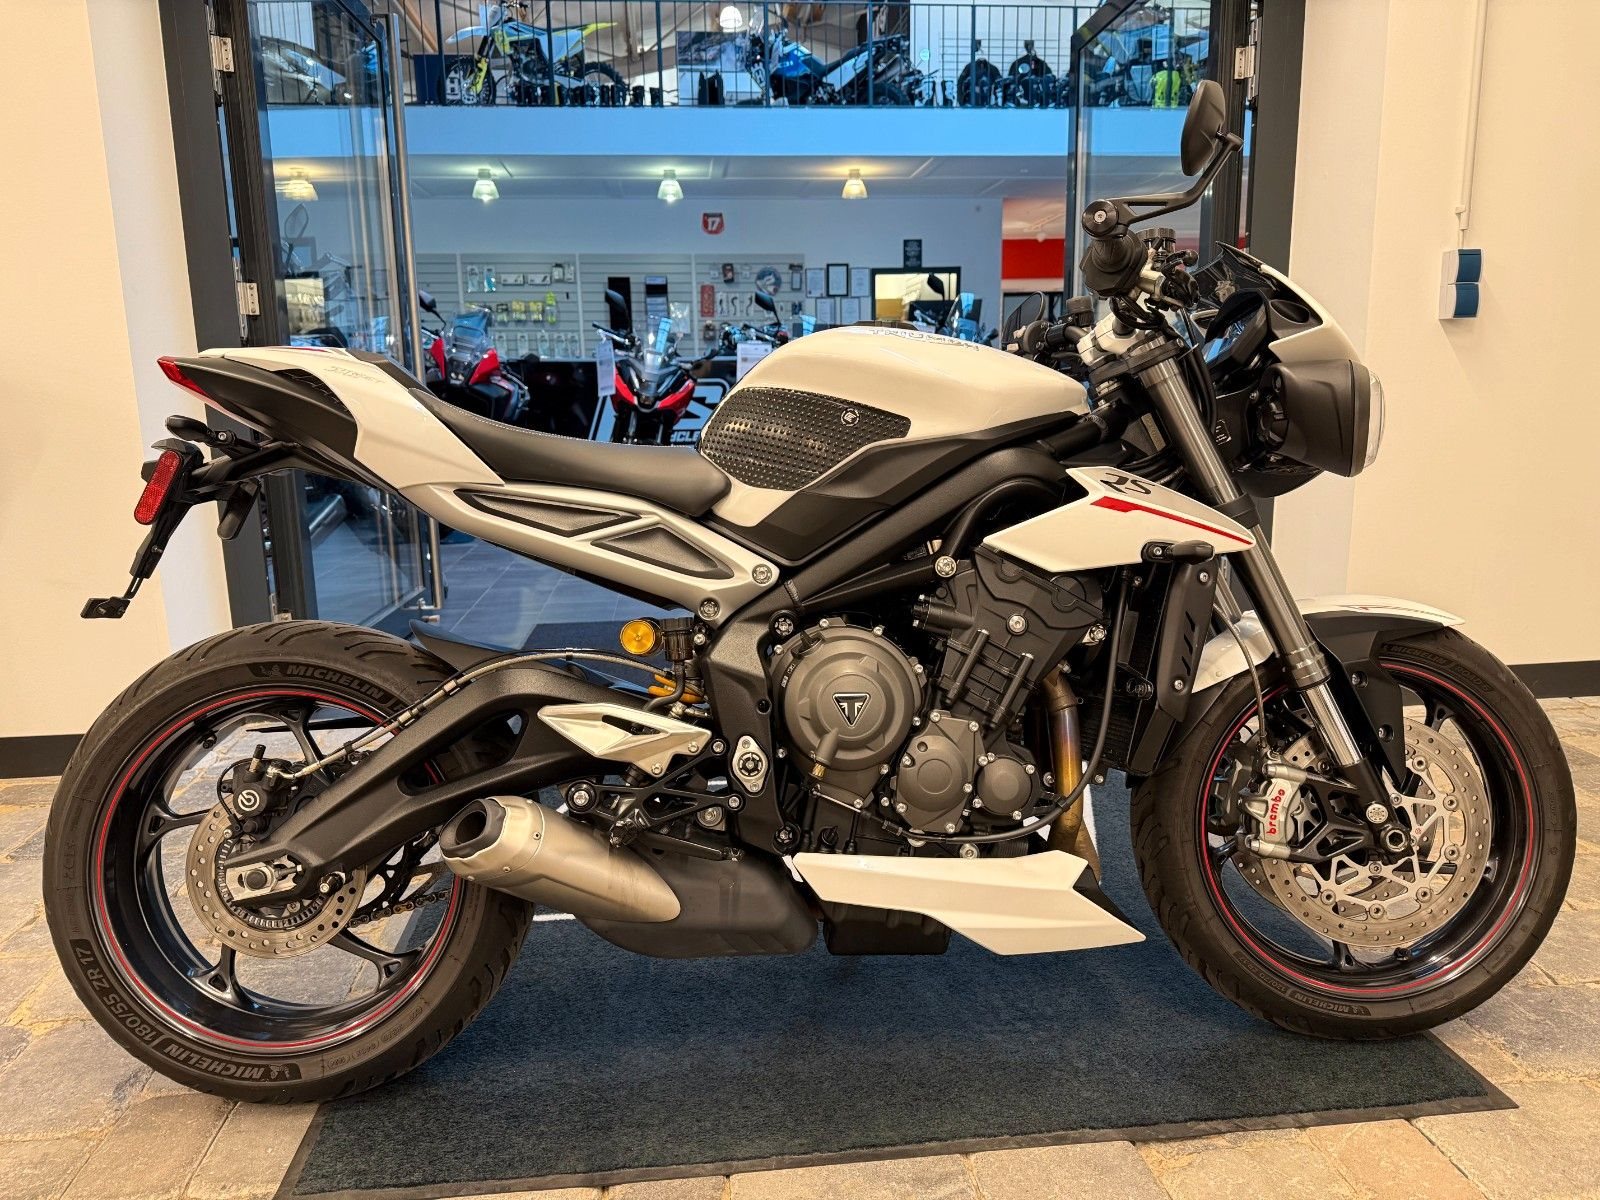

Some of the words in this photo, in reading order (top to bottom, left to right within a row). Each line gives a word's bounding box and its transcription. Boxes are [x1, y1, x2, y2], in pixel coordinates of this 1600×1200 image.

[1100, 472, 1155, 494] RS
[286, 664, 385, 699] MICHELIN
[1266, 788, 1286, 835] brembo
[75, 947, 94, 965] 17
[87, 967, 110, 992] ZR
[103, 993, 157, 1042] 180/55
[1295, 994, 1349, 1013] MICHELIN
[163, 1043, 265, 1079] MICHELIN
